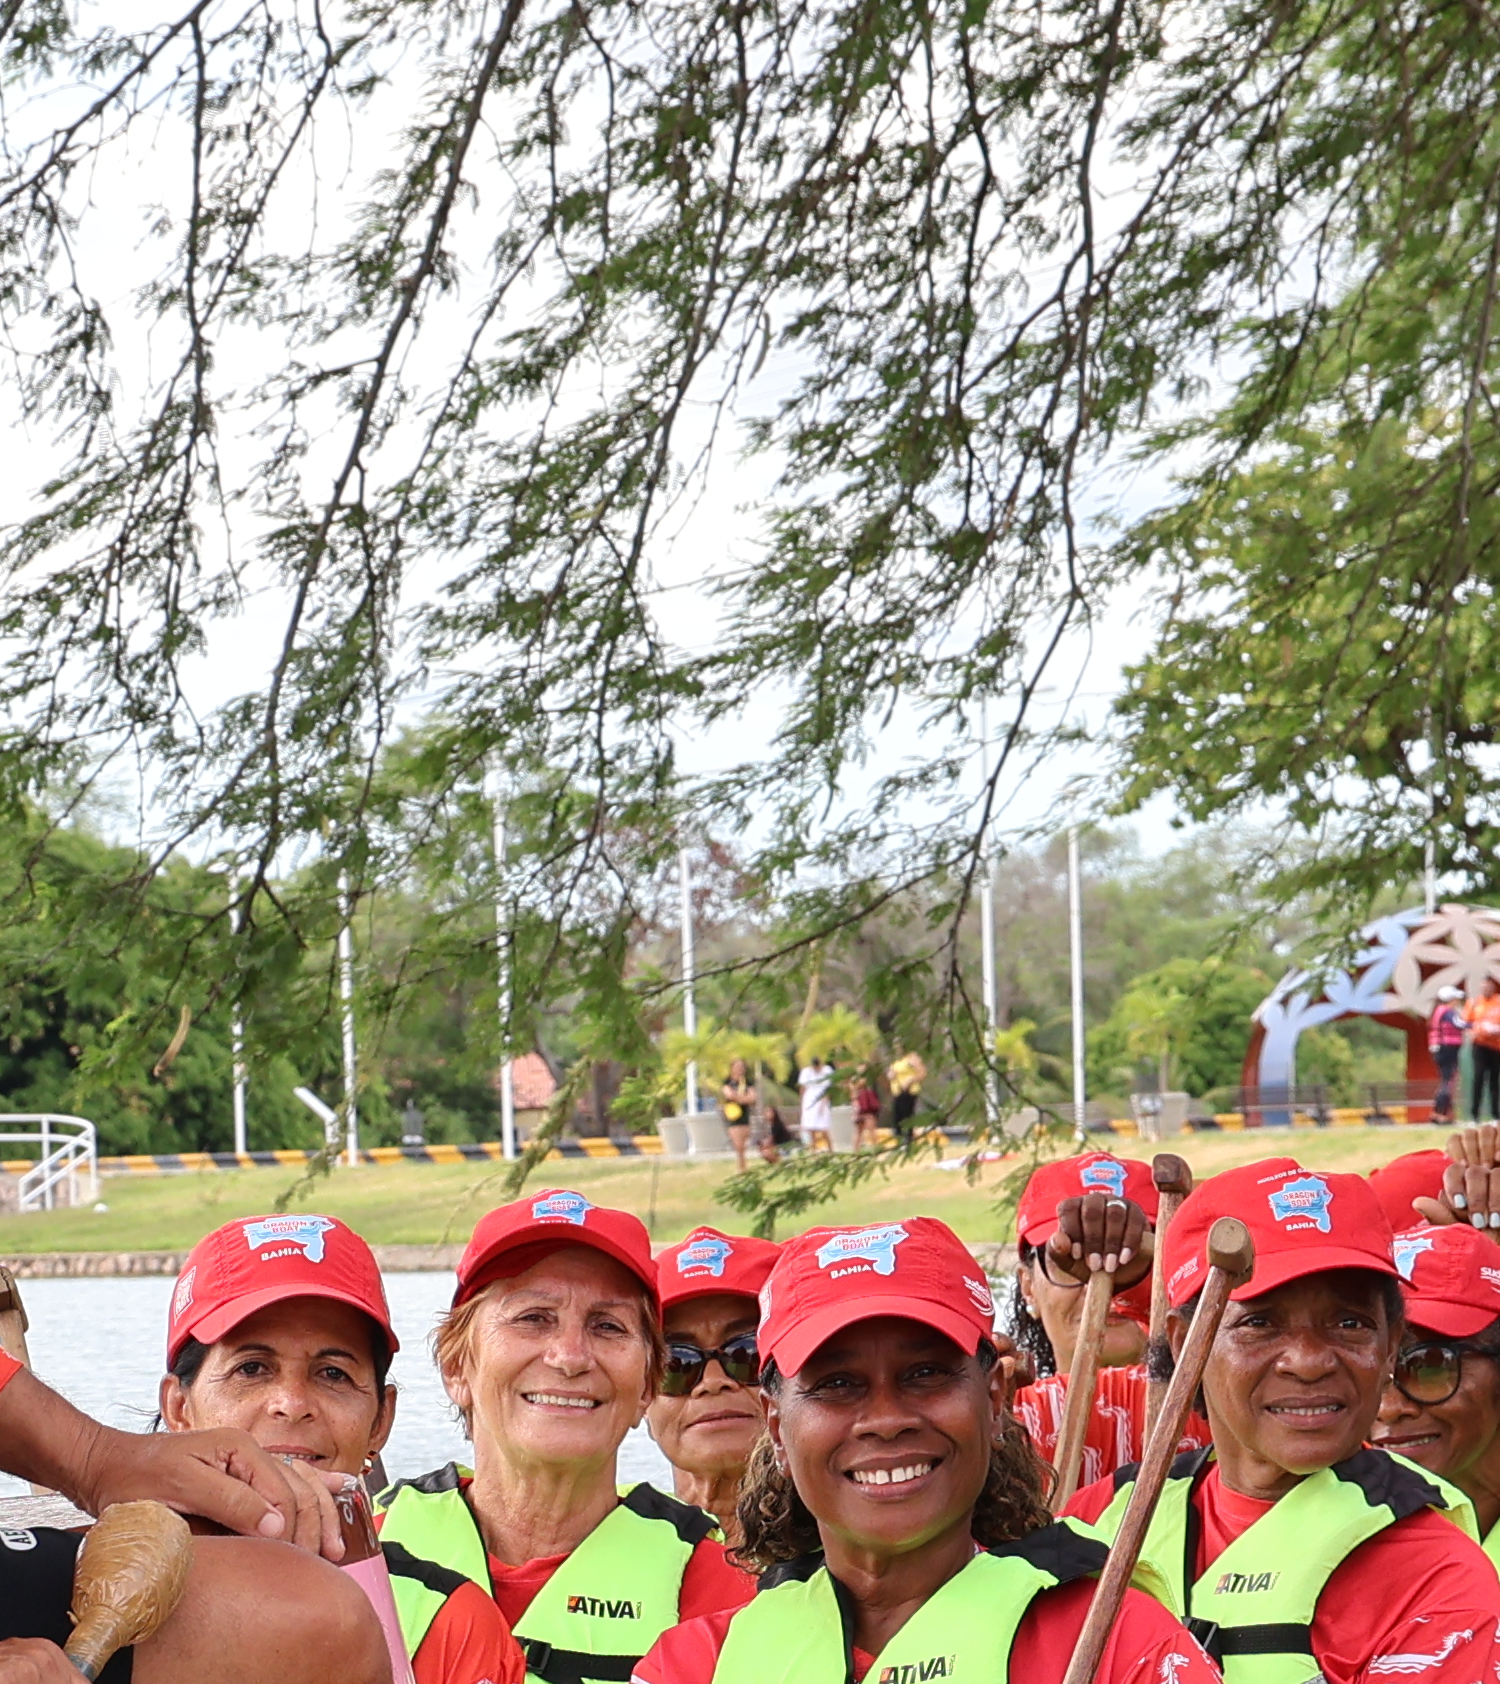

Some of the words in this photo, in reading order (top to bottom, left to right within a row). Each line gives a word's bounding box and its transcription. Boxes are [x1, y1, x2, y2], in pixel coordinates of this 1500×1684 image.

[1282, 1191, 1316, 1201] DRAGON
[262, 1219, 308, 1229] DRAGON
[1285, 1221, 1316, 1232] BAHIA
[271, 1226, 300, 1234] BOAT
[833, 1233, 881, 1248] DRAGON
[841, 1240, 872, 1251] BOAT
[260, 1246, 303, 1262] BAHIA
[829, 1264, 873, 1280] BAHIA
